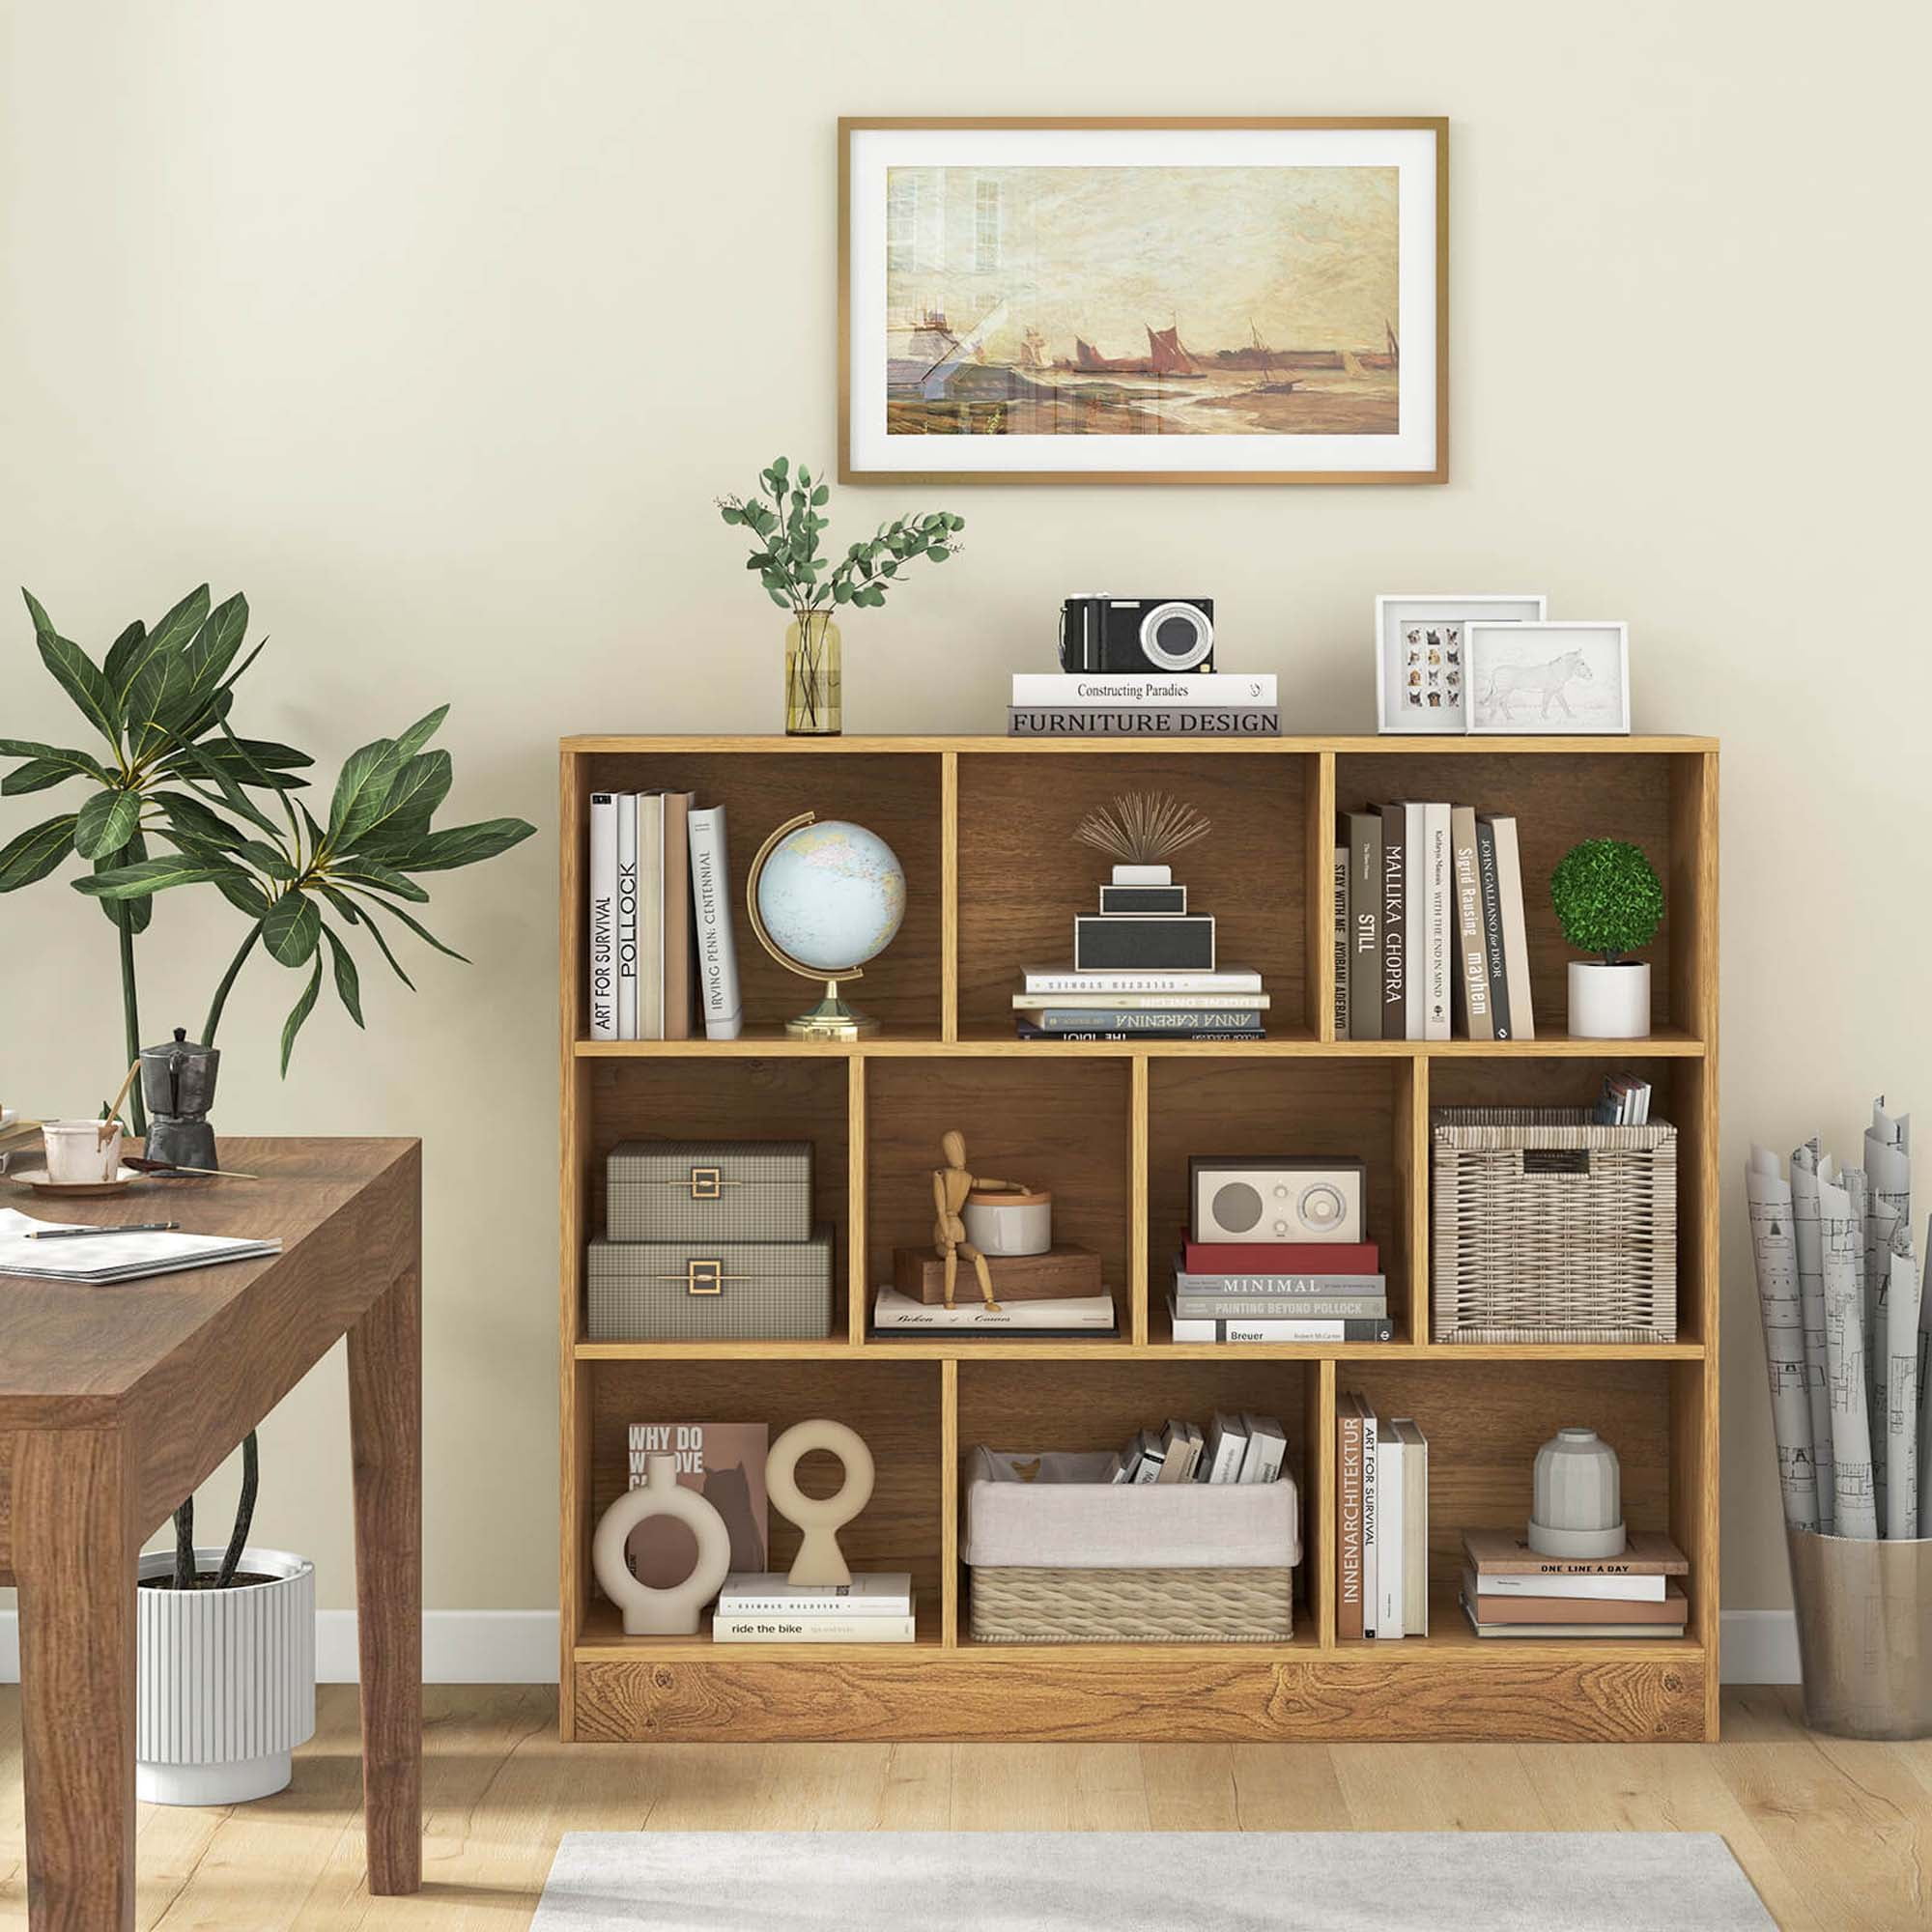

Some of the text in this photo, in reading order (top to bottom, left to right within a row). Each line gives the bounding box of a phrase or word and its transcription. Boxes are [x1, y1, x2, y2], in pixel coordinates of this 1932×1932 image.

[1077, 683, 1189, 699] Constructing Paradies
[1013, 714, 1279, 732] FURNITURE DESIGN
[1481, 839, 1492, 871] JOHN
[1335, 865, 1346, 932] STAY WITH ME
[1458, 847, 1478, 936] Sigrid Rausing
[1485, 872, 1498, 932] GALLIANO
[620, 863, 637, 978] POLLOCK
[699, 850, 723, 1010] IRVING PENN: CENTENNIAL
[1358, 914, 1376, 953] STILL
[1386, 846, 1402, 1004] MALLIKA CHOPRA
[1434, 892, 1442, 997] WITH THE END IN MIND
[595, 897, 611, 1030] ART FOR SURVIVAL
[1467, 952, 1489, 1014] mayhem
[1491, 949, 1502, 978] DIOR
[1116, 1013, 1201, 1028] KARENINA
[1204, 1013, 1252, 1027] ANNA
[1224, 1279, 1321, 1293] MINIMAL
[1231, 1331, 1264, 1341] Breuer
[629, 1426, 703, 1451] WHY DO
[1344, 1417, 1359, 1604] INNENARCHITEKTUR
[1364, 1427, 1375, 1547] ART FOR SURVIVAL
[731, 1624, 754, 1634] ride
[757, 1624, 776, 1634] the
[779, 1624, 803, 1634] bike
